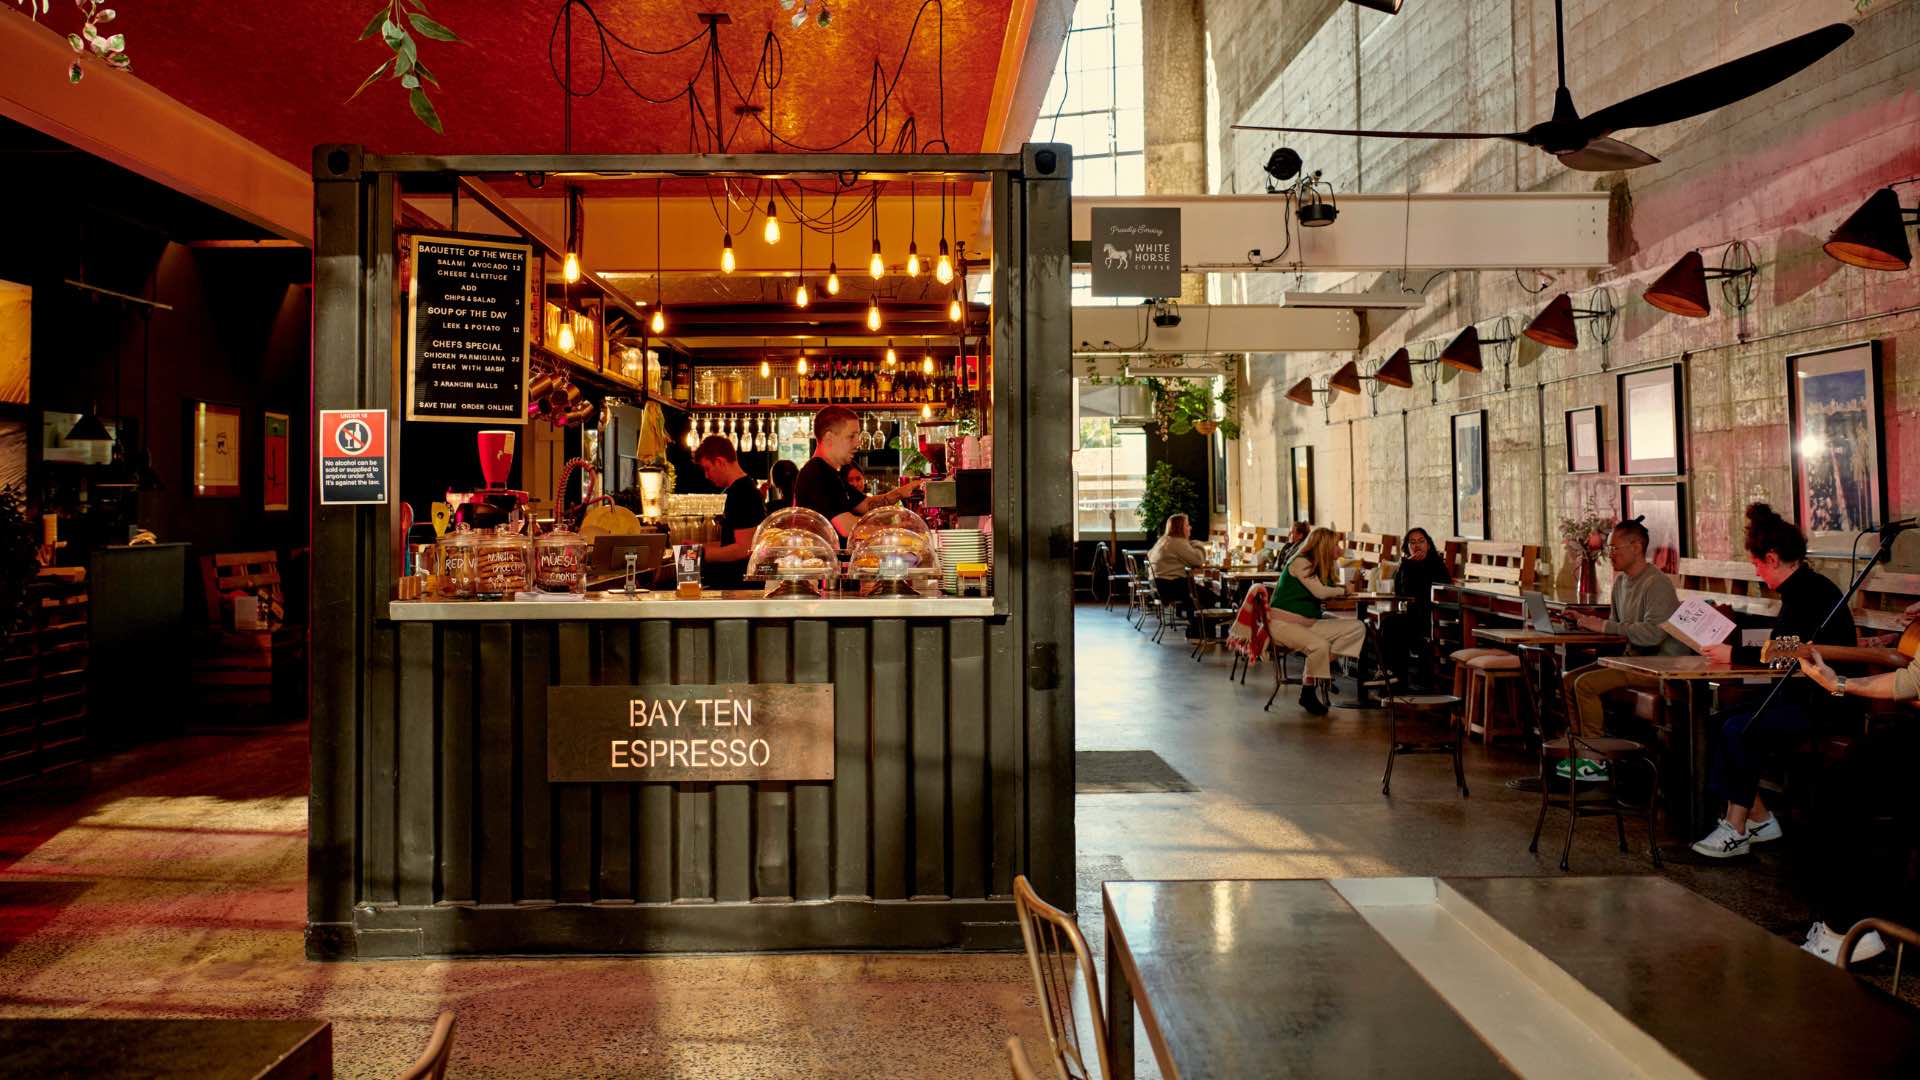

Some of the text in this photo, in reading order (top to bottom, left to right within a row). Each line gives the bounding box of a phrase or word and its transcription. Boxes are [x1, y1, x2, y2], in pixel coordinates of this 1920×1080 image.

[1135, 243, 1170, 253] WHITE
[468, 249, 480, 257] OF
[482, 250, 497, 259] THE
[499, 252, 523, 261] WEEK
[1135, 253, 1170, 262] HORSE
[437, 259, 466, 267] SALAMI
[472, 262, 508, 270] AVOCADO
[437, 270, 467, 278] CHEESE
[427, 307, 454, 315] SOUP
[470, 310, 487, 318] THE
[490, 311, 507, 319] DAY
[471, 324, 500, 332] POTATO
[432, 340, 503, 351] CHEFS SPECIAL
[459, 354, 506, 362] PARMIGIANA
[445, 558, 465, 571] RED
[629, 699, 752, 728] BAY TEN
[611, 738, 770, 768] ESPRESSO
